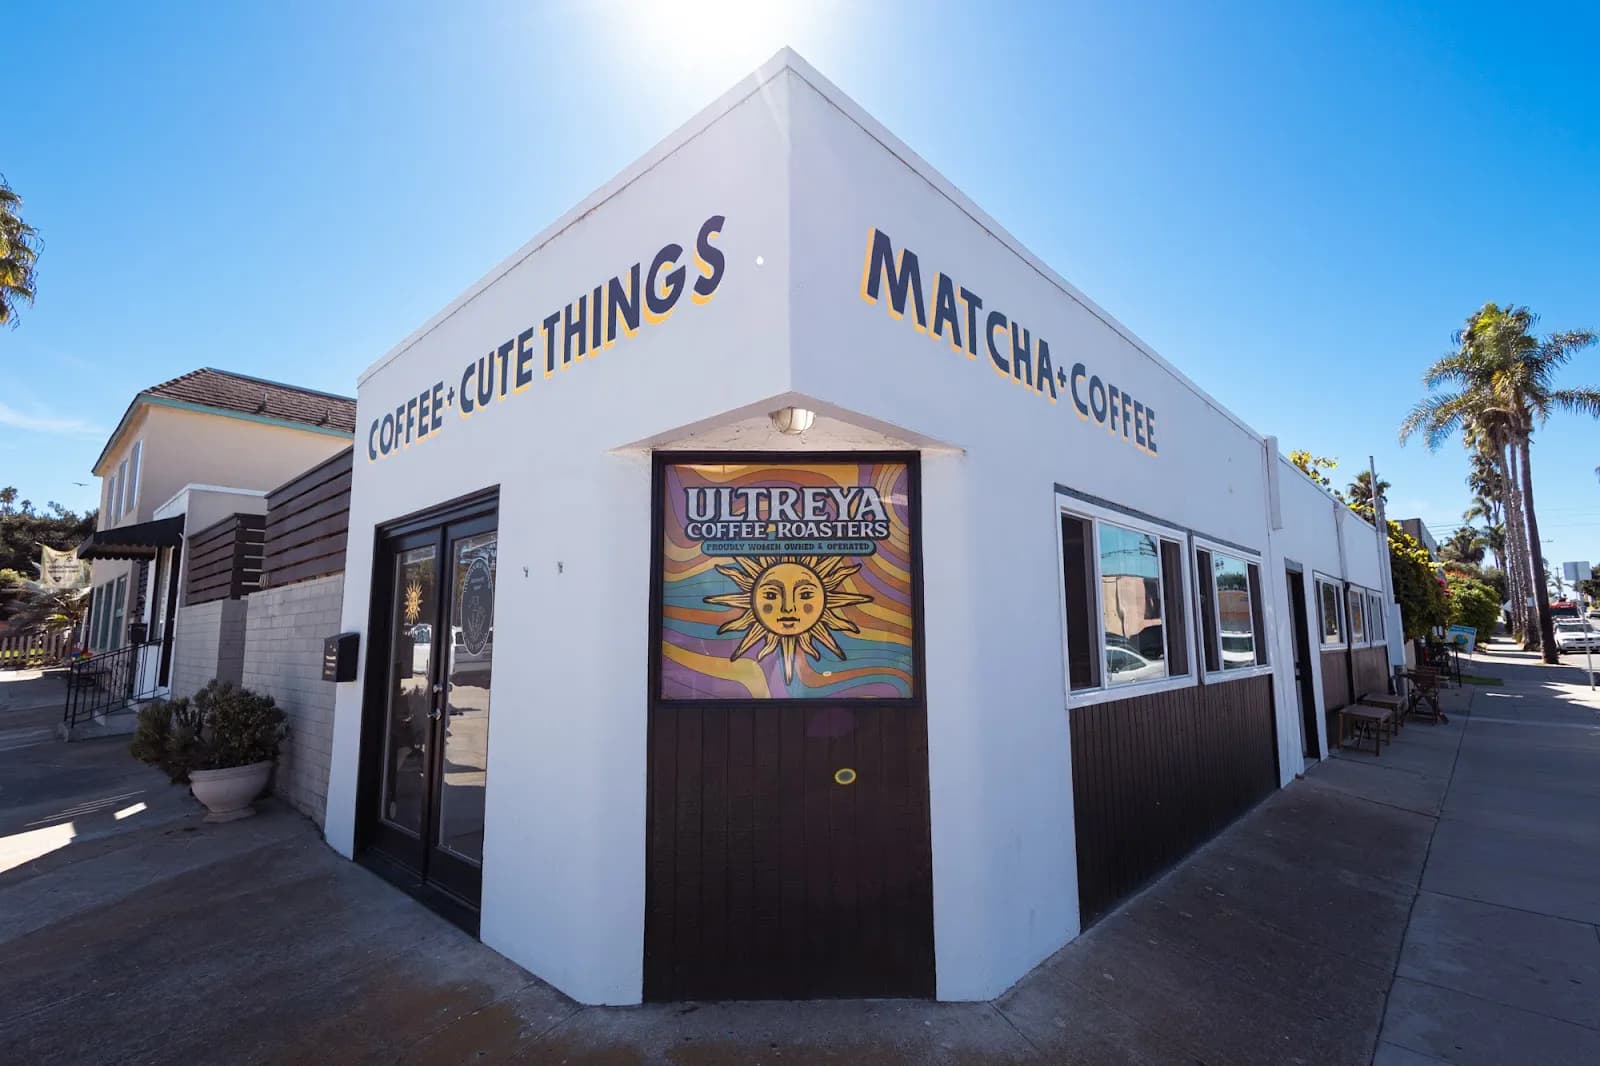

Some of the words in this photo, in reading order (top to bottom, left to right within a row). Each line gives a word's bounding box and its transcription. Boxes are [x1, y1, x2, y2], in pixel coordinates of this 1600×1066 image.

[367, 381, 444, 464] COFFEE
[458, 326, 534, 418] CUTE
[540, 214, 726, 378] THINGS
[861, 226, 1057, 404] MATCHA
[1069, 362, 1159, 457] COFFEE
[685, 487, 889, 521] ULTREYA
[686, 521, 767, 539] COFFEE
[776, 521, 889, 538] ROASTERS
[705, 543, 745, 551] PROUDLY
[748, 543, 782, 551] WOMEN
[783, 543, 815, 551] OWNED
[826, 543, 870, 551] OPERATED
